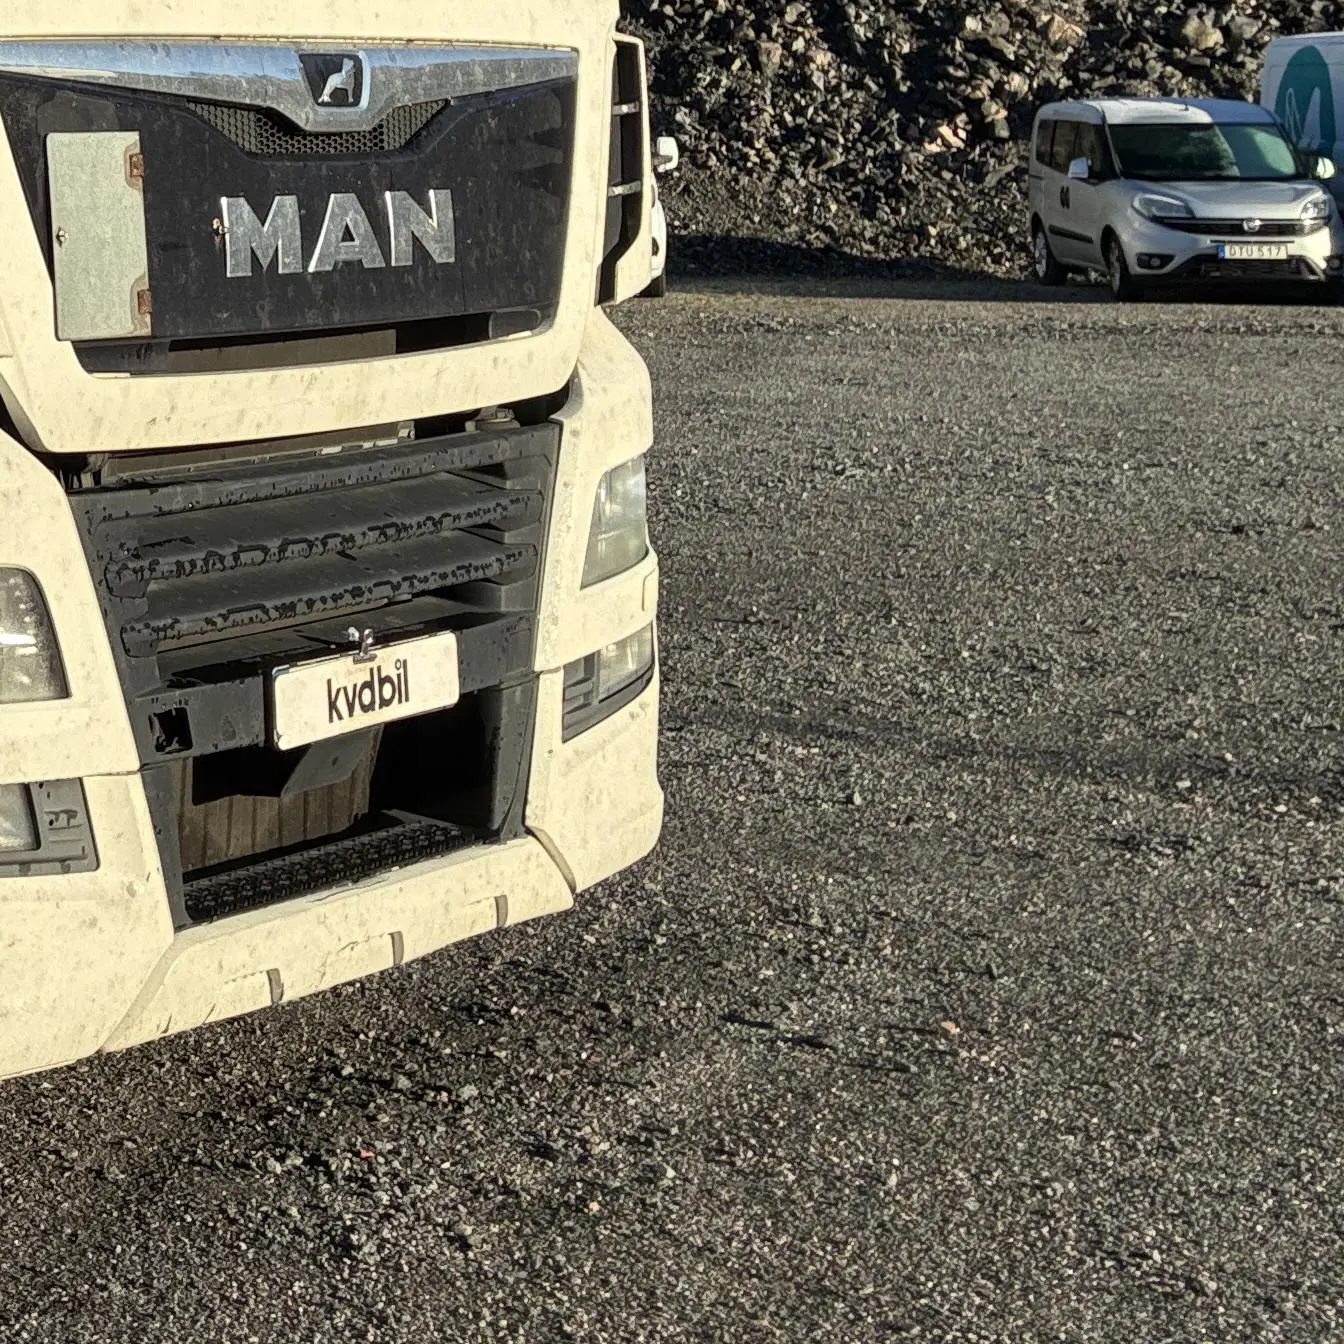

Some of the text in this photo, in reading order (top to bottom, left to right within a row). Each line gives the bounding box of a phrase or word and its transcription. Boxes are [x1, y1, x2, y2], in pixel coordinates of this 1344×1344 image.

[220, 188, 456, 278] MAN
[1257, 244, 1281, 257] 517
[326, 659, 410, 724] kvdbil
